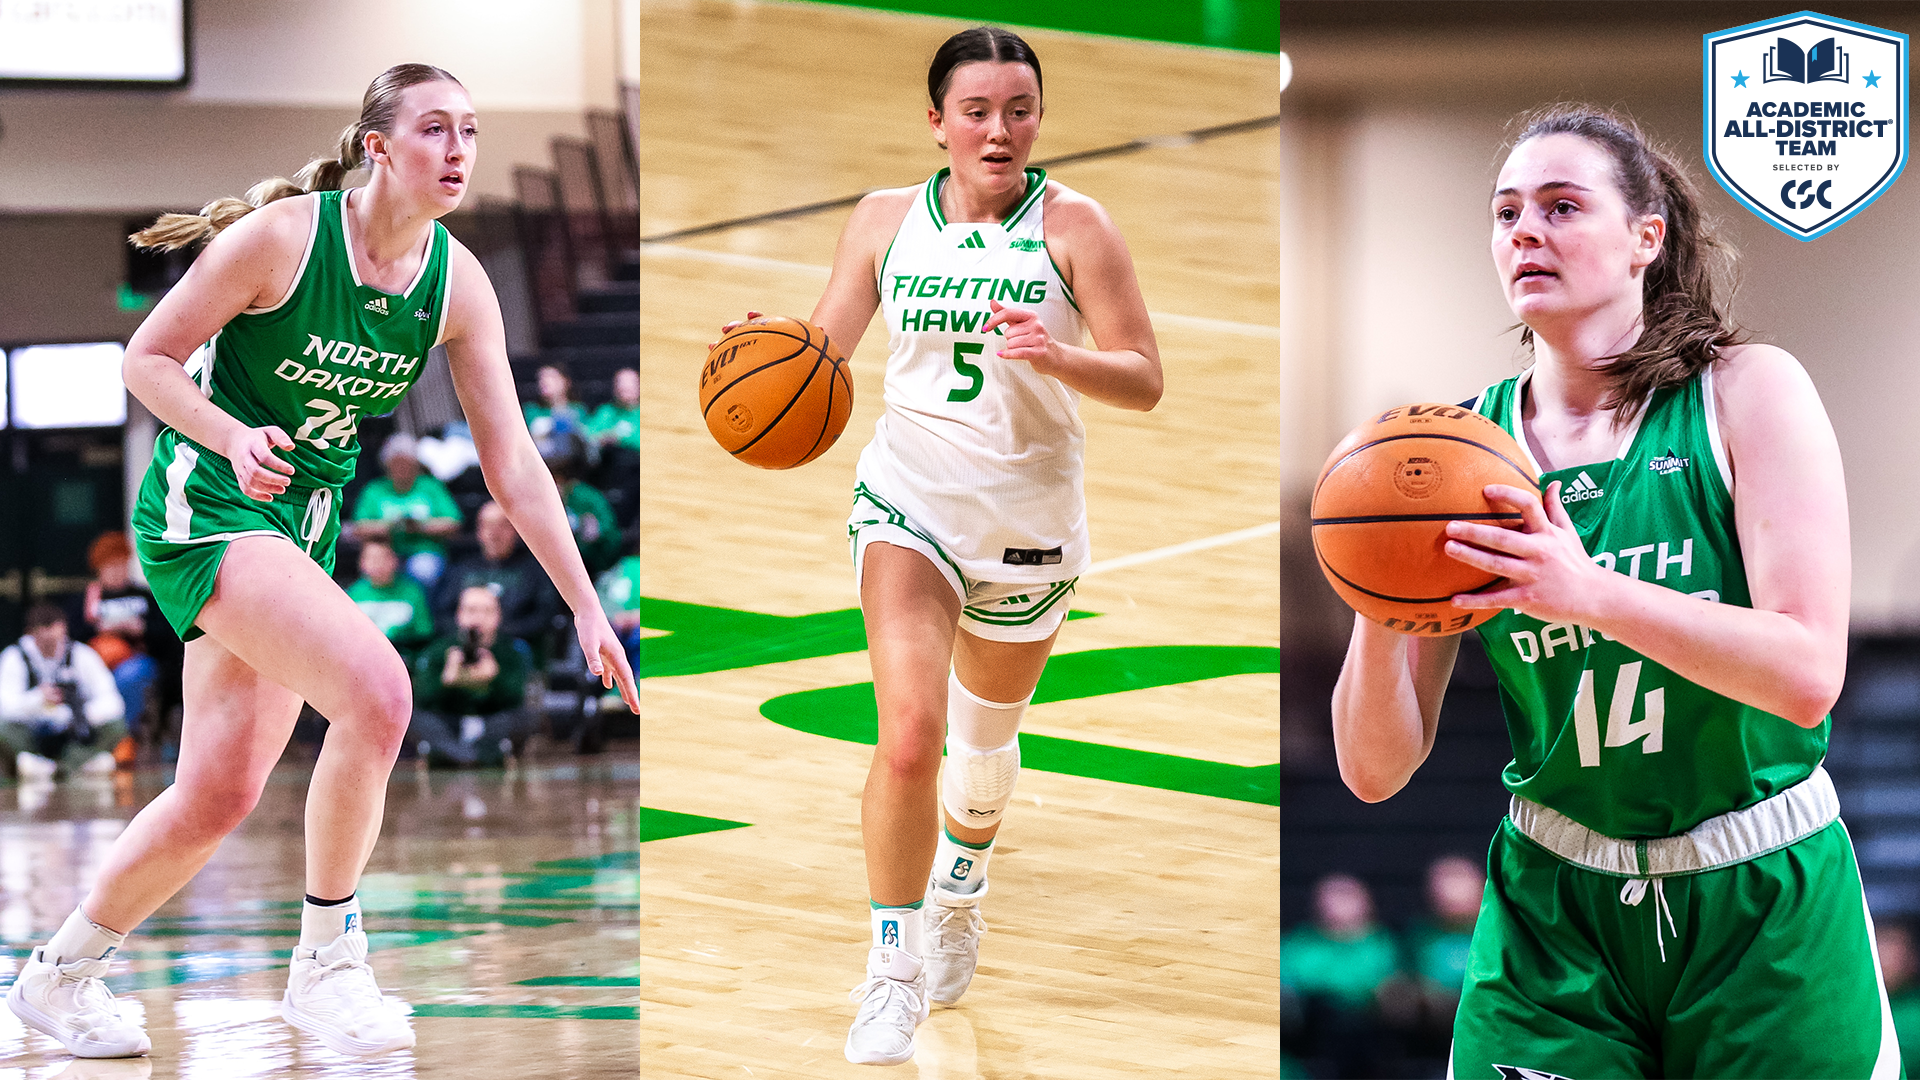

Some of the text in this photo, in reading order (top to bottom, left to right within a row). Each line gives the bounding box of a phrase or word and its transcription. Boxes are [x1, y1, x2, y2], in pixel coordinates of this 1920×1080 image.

[893, 275, 1048, 304] FIGHTING
[364, 303, 390, 316] adidas
[302, 333, 420, 376] NORTH
[702, 345, 739, 390] EVO
[946, 341, 985, 403] 5
[274, 358, 410, 399] DAKOTA
[294, 398, 361, 450] 24
[1377, 405, 1469, 424] EVO
[1648, 457, 1690, 471] SUMMIT
[1561, 488, 1604, 504] adidas
[1384, 612, 1474, 633] EVO
[1574, 660, 1665, 768] 14
